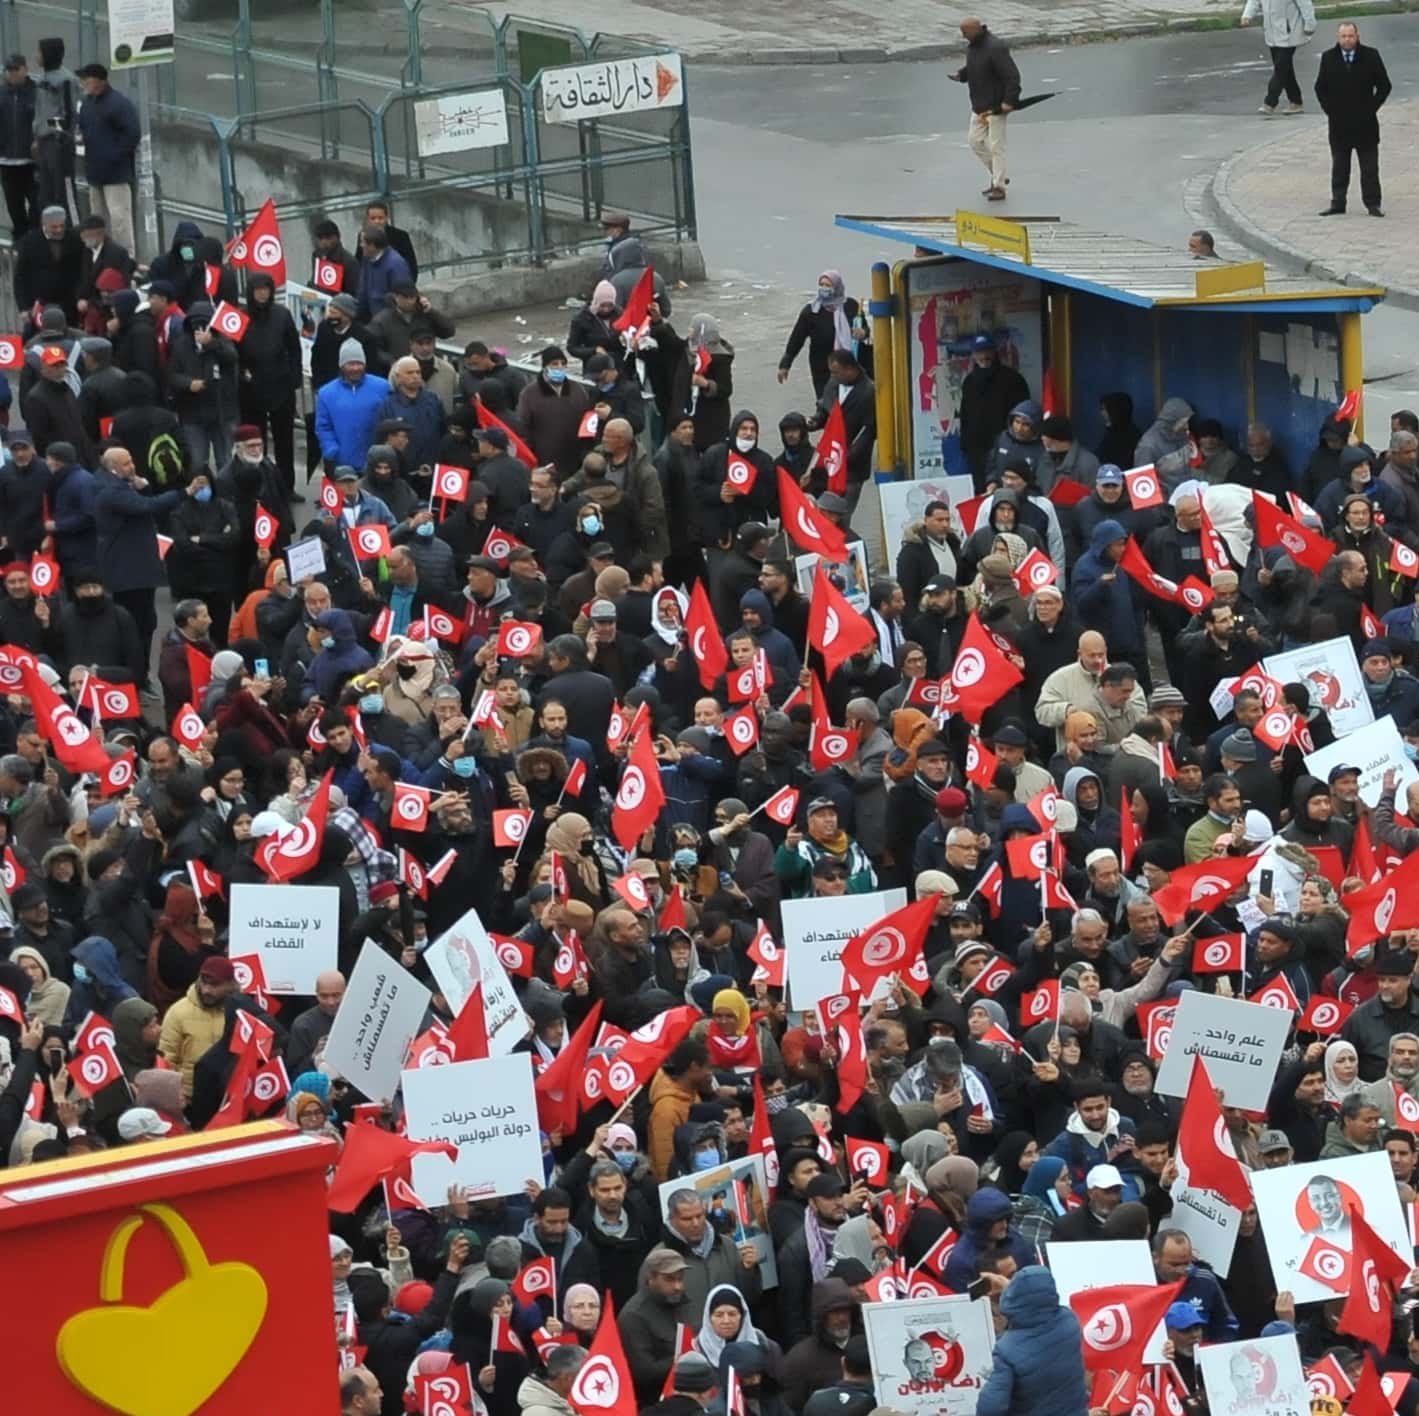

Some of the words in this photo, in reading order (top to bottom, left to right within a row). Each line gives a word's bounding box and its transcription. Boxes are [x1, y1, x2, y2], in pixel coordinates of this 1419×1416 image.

[547, 64, 620, 111] الثقافة
[613, 62, 653, 109] دار
[264, 938, 305, 950] القضاء
[1205, 1028, 1236, 1043] واحد
[1239, 1034, 1265, 1048] علم
[1249, 1056, 1263, 1067] ما
[442, 1110, 477, 1126] حريات
[481, 1103, 516, 1119] حريات
[503, 1122, 532, 1138] دولة
